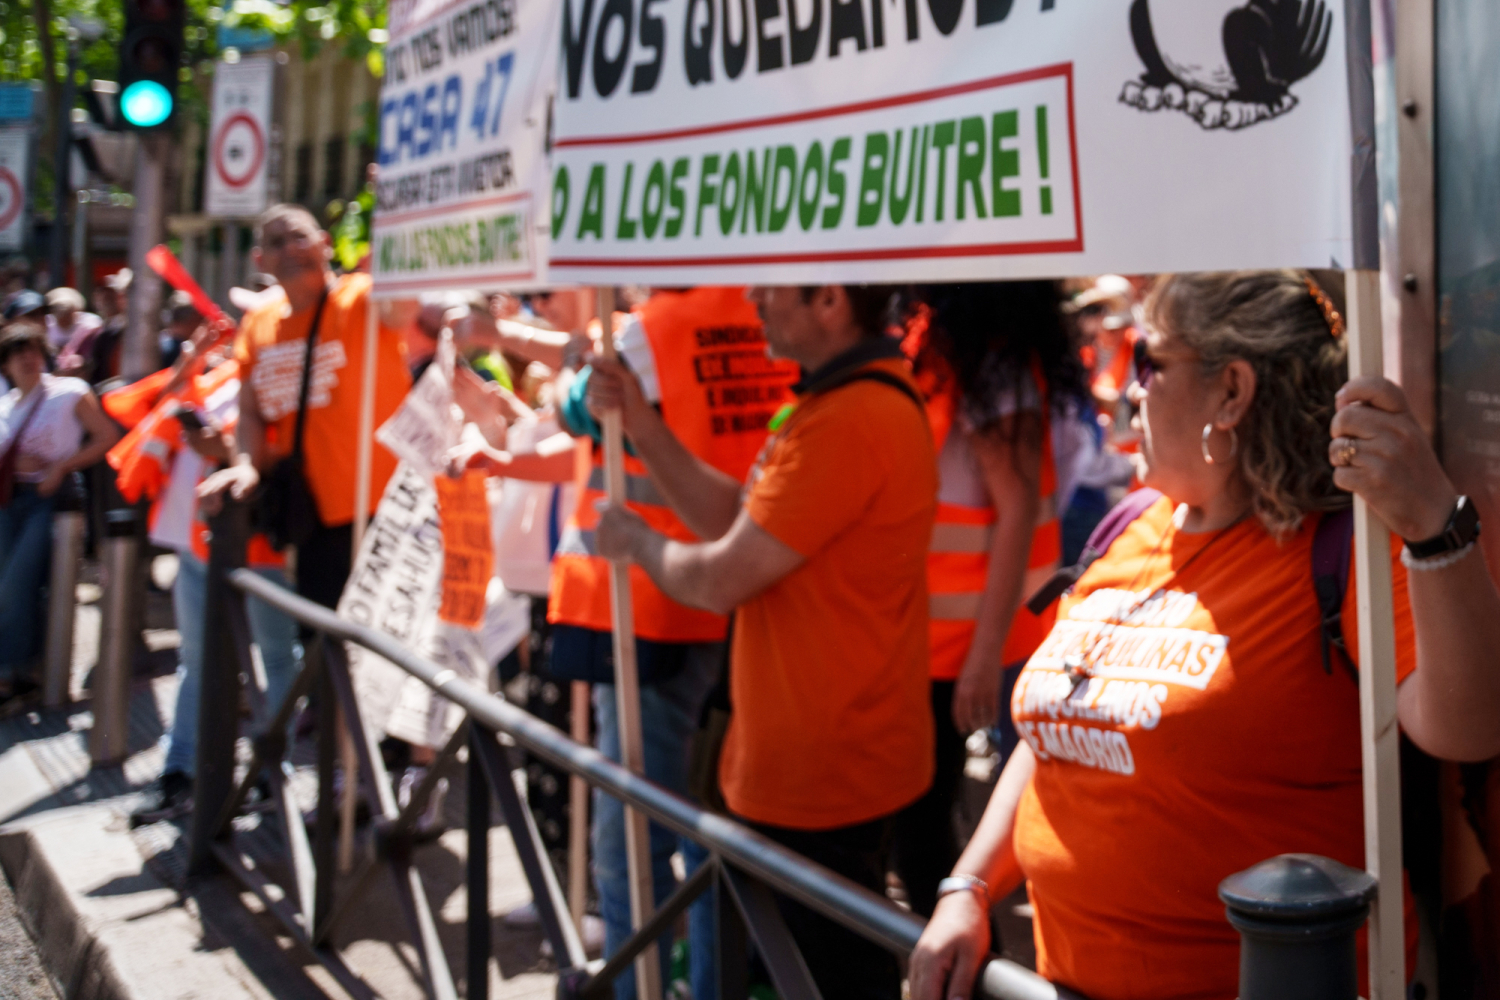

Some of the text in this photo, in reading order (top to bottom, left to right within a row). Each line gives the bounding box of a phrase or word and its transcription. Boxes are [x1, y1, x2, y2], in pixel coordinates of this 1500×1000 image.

[379, 72, 461, 166] CASA
[472, 49, 516, 138] 47
[575, 161, 606, 241] A
[615, 156, 690, 241] LOS
[694, 134, 851, 238] FONDOS
[856, 105, 1023, 227] BUITRE
[1037, 721, 1136, 776] MADRID
